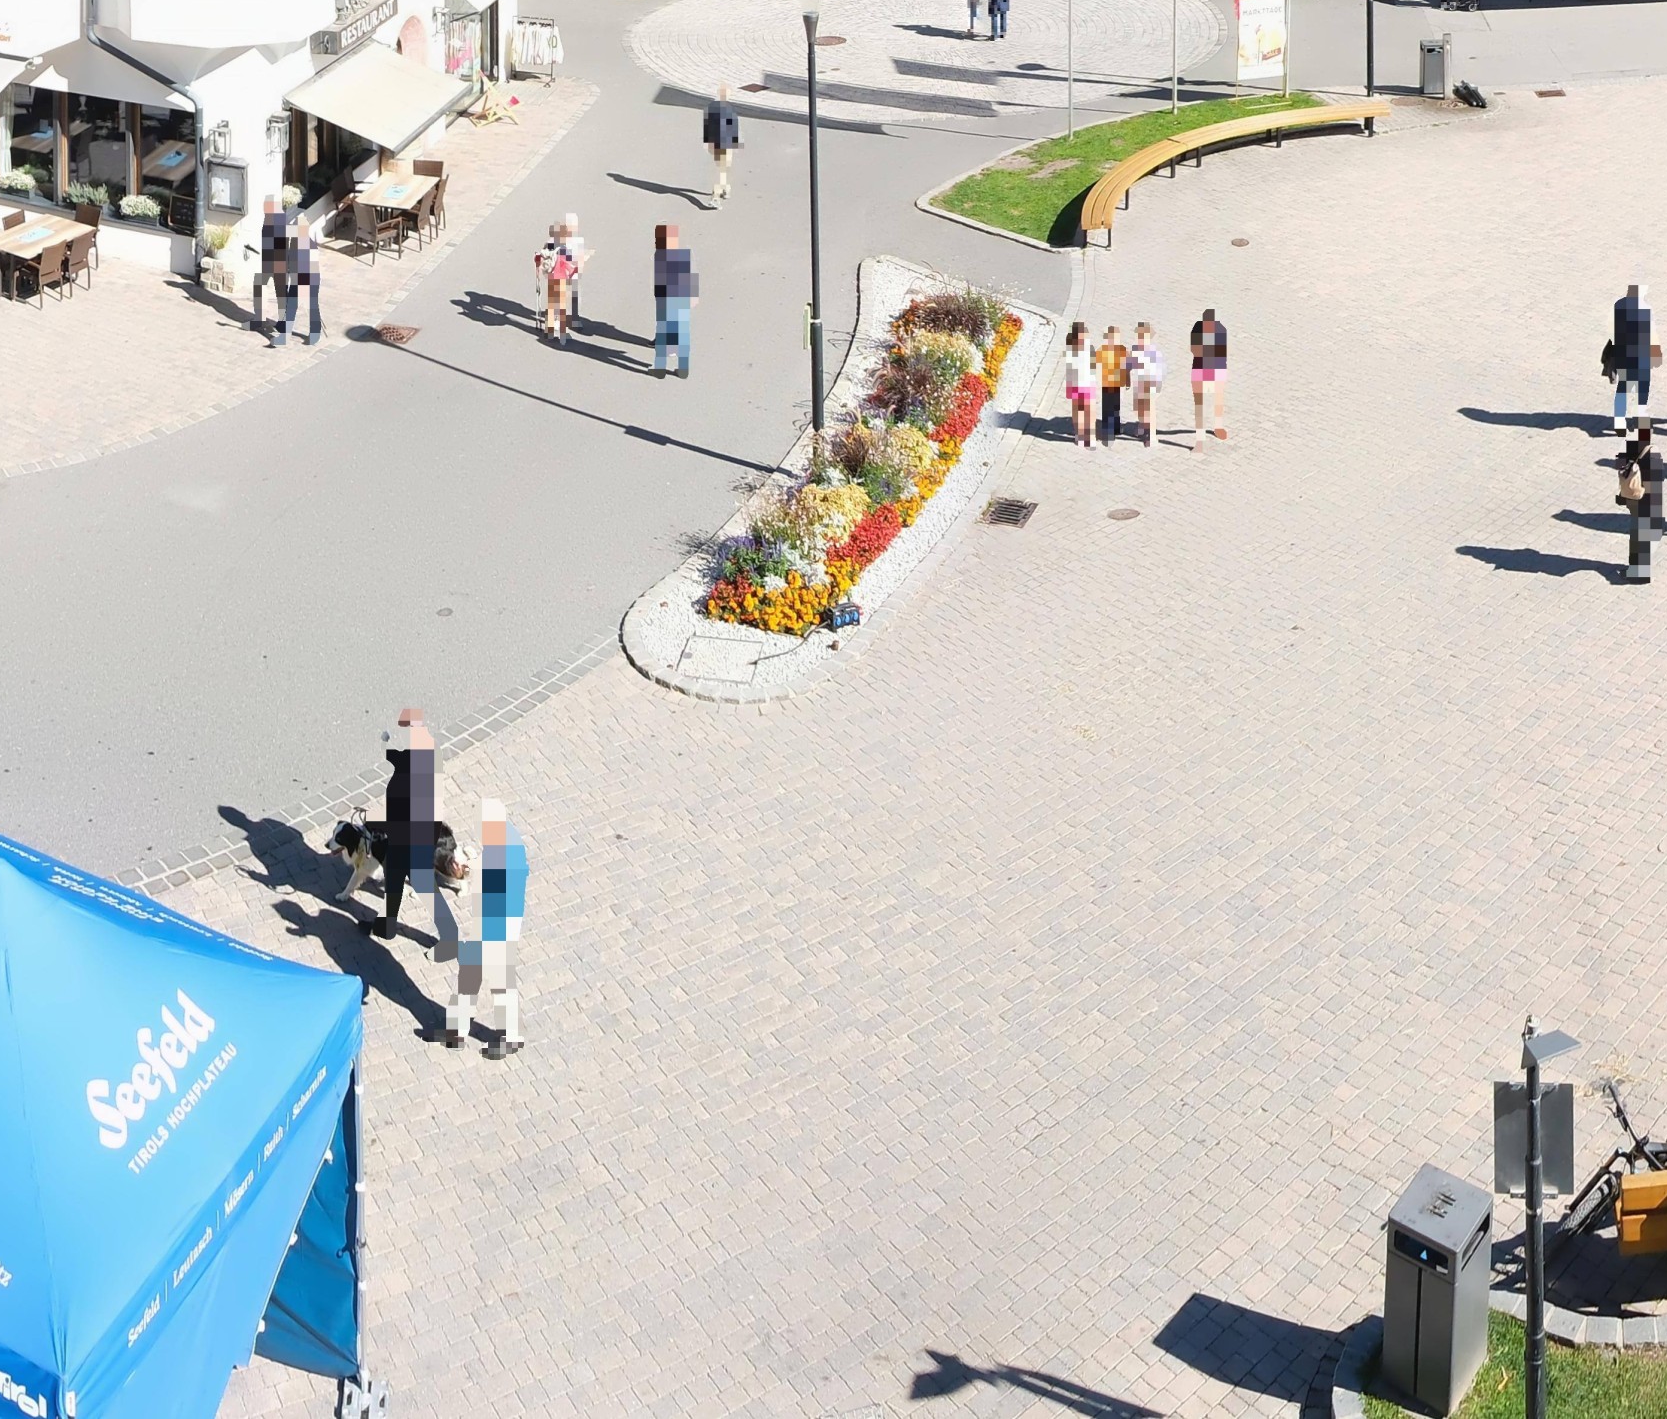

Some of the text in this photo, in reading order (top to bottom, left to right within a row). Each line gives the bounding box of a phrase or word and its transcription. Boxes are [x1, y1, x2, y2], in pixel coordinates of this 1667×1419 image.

[341, 0, 395, 48] RESTAURANT
[86, 988, 215, 1149] Seefeld
[128, 1042, 238, 1174] TIROLS HOCHPLATEAU
[173, 1226, 213, 1288] Leutasch
[224, 1169, 254, 1219] Mösern
